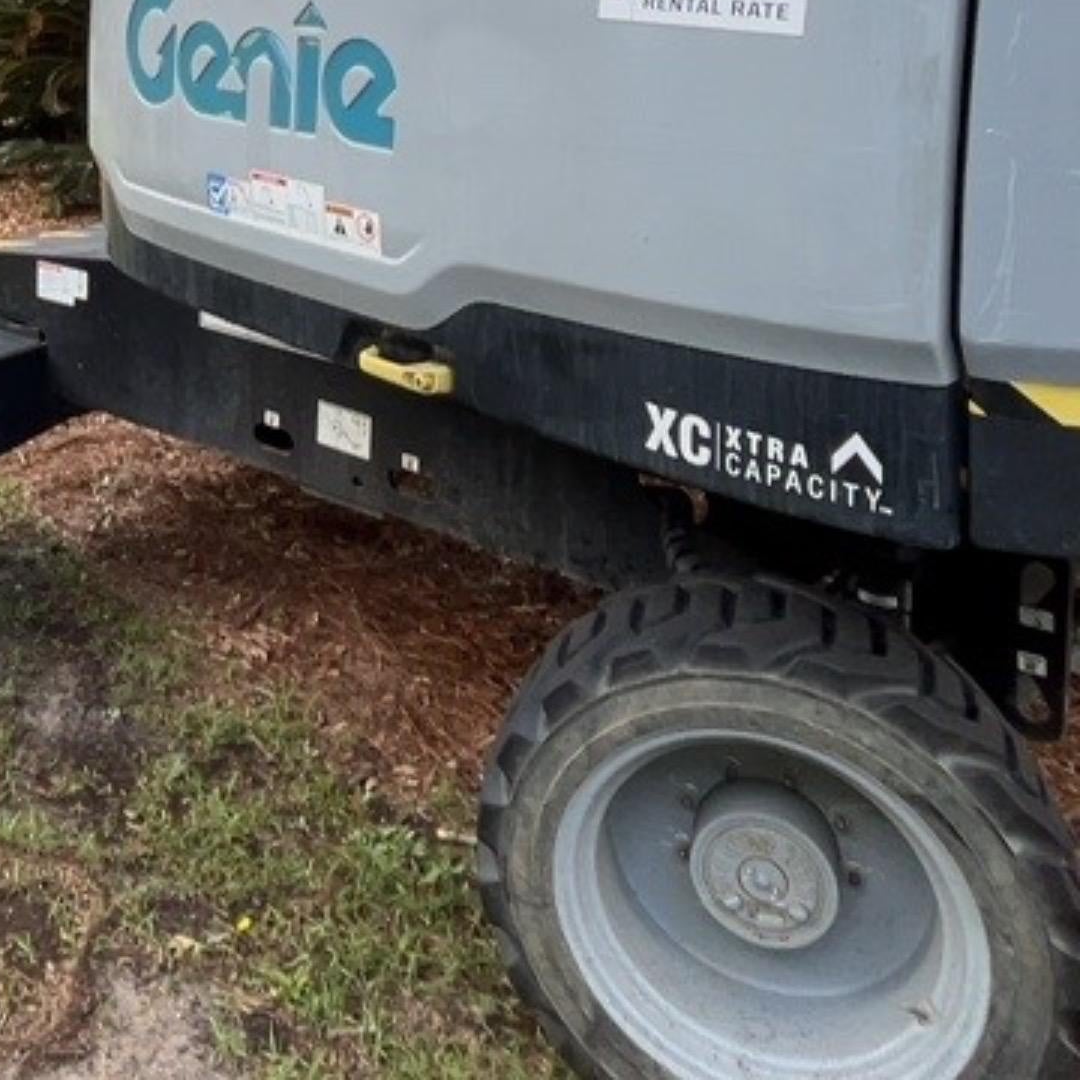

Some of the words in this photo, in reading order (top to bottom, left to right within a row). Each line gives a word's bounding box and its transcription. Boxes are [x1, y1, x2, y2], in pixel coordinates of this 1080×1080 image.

[644, 401, 713, 468] XC
[724, 423, 810, 470] XTRA
[724, 450, 884, 514] CAPACITY
